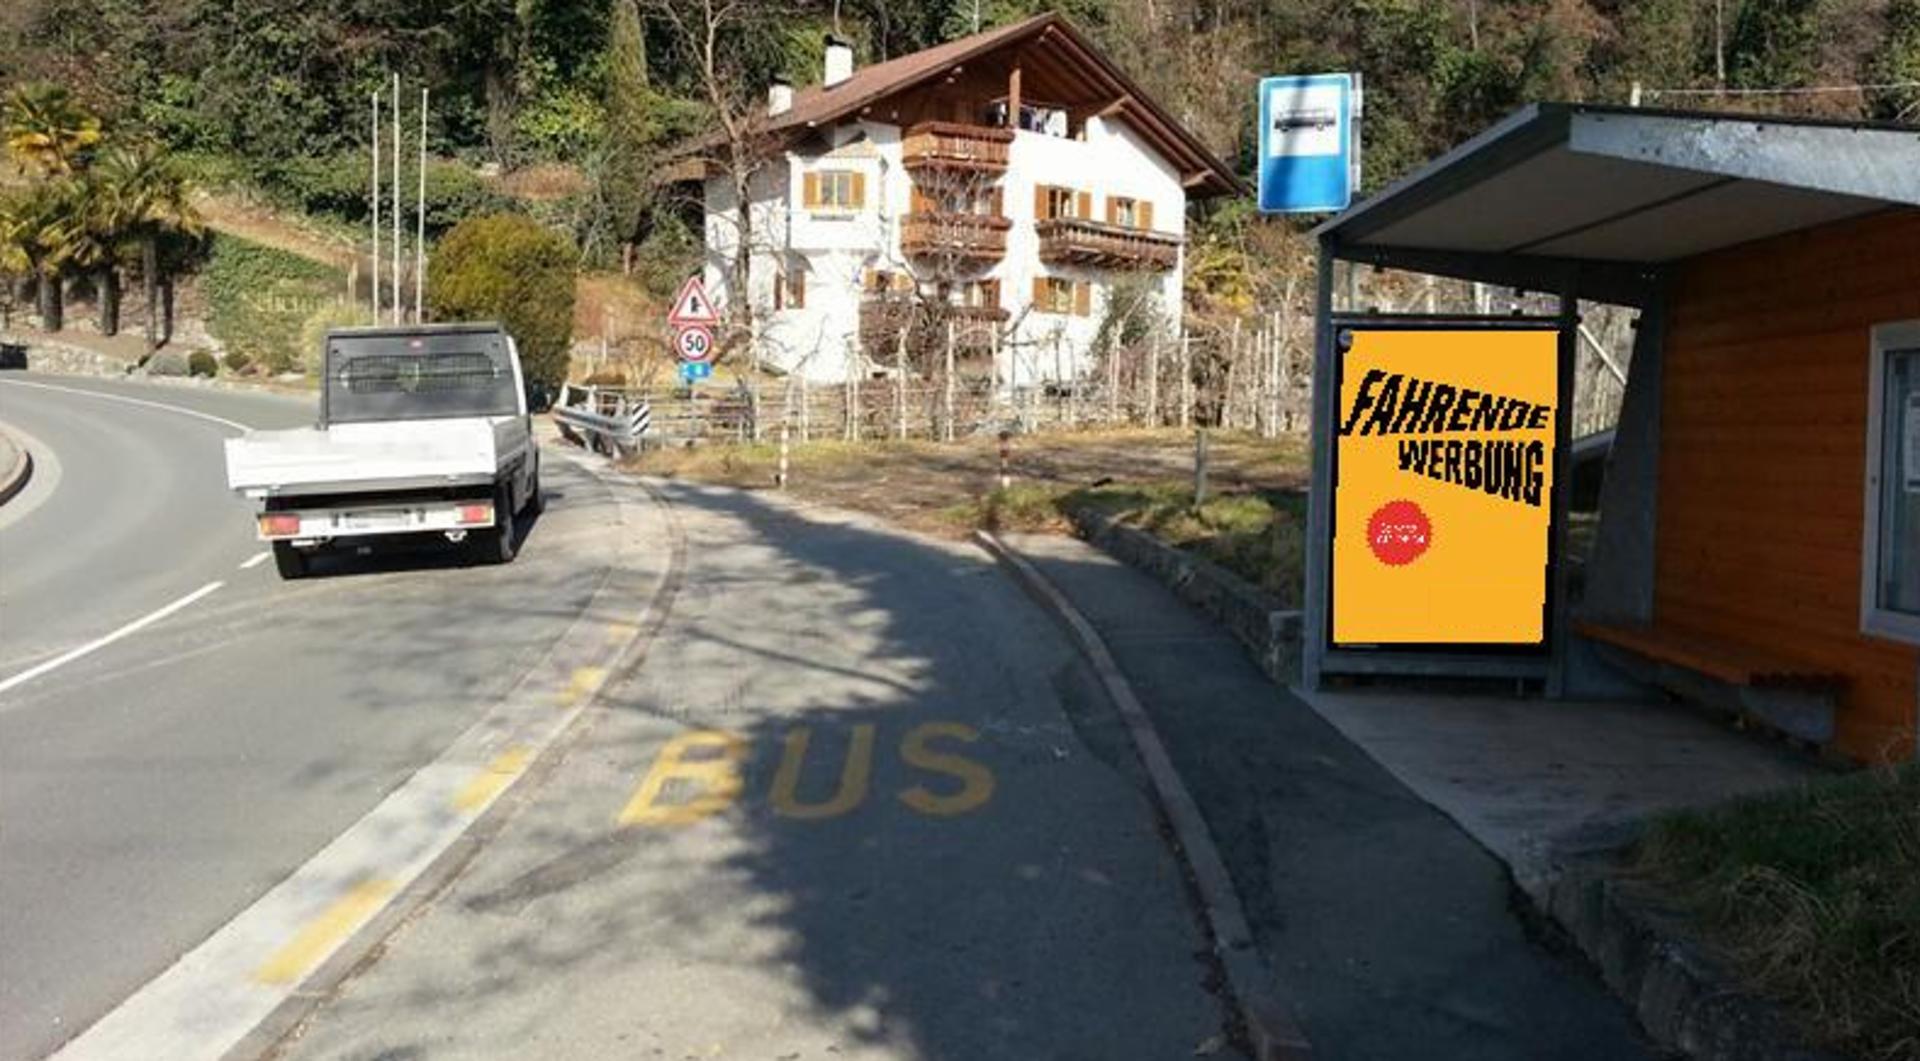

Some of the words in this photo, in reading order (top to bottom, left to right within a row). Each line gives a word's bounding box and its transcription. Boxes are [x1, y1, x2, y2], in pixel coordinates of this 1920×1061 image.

[685, 334, 705, 351] 50
[1338, 369, 1550, 436] FAHRENDE
[1398, 440, 1544, 507] WERBUNG
[617, 722, 997, 826] BUS
